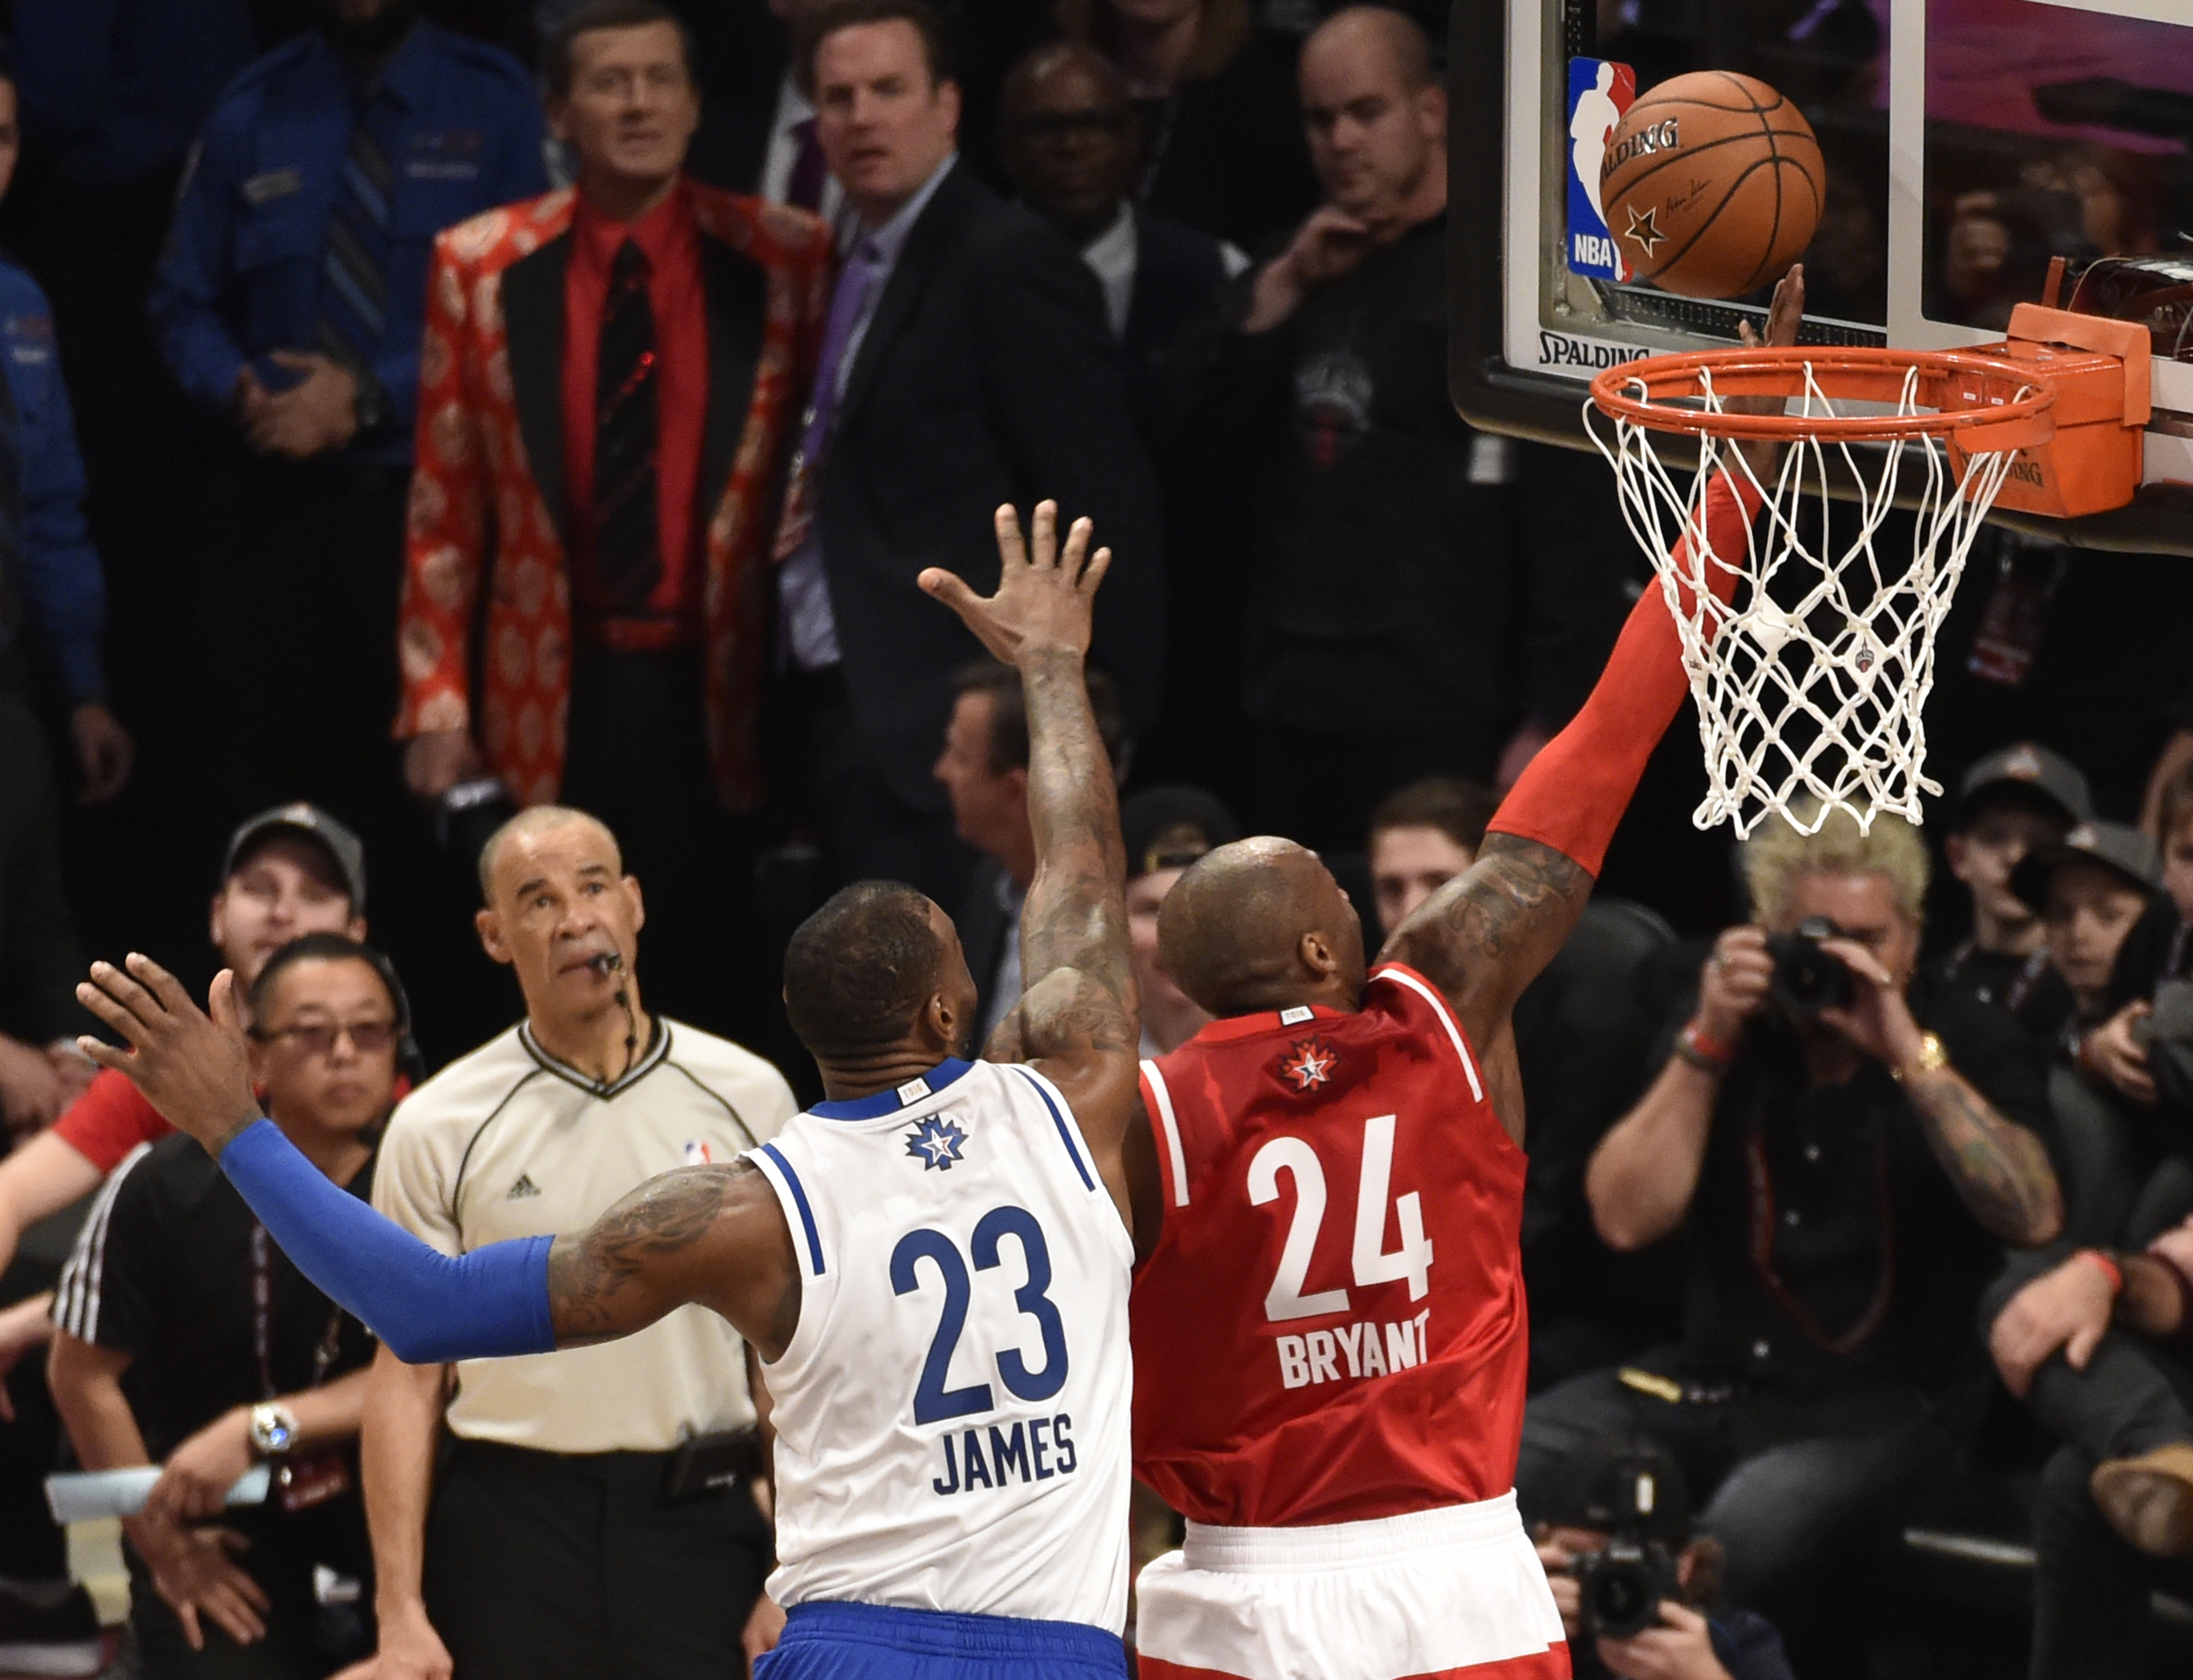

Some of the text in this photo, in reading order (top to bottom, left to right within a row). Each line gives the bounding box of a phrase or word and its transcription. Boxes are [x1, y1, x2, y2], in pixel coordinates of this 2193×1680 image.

[1600, 117, 1678, 179] ALDING
[1575, 233, 1612, 267] NBA
[1247, 1114, 1433, 1322] 24
[889, 1205, 1068, 1426] 23
[1277, 1308, 1430, 1389] BRYANT
[933, 1413, 1077, 1495] JAMES
